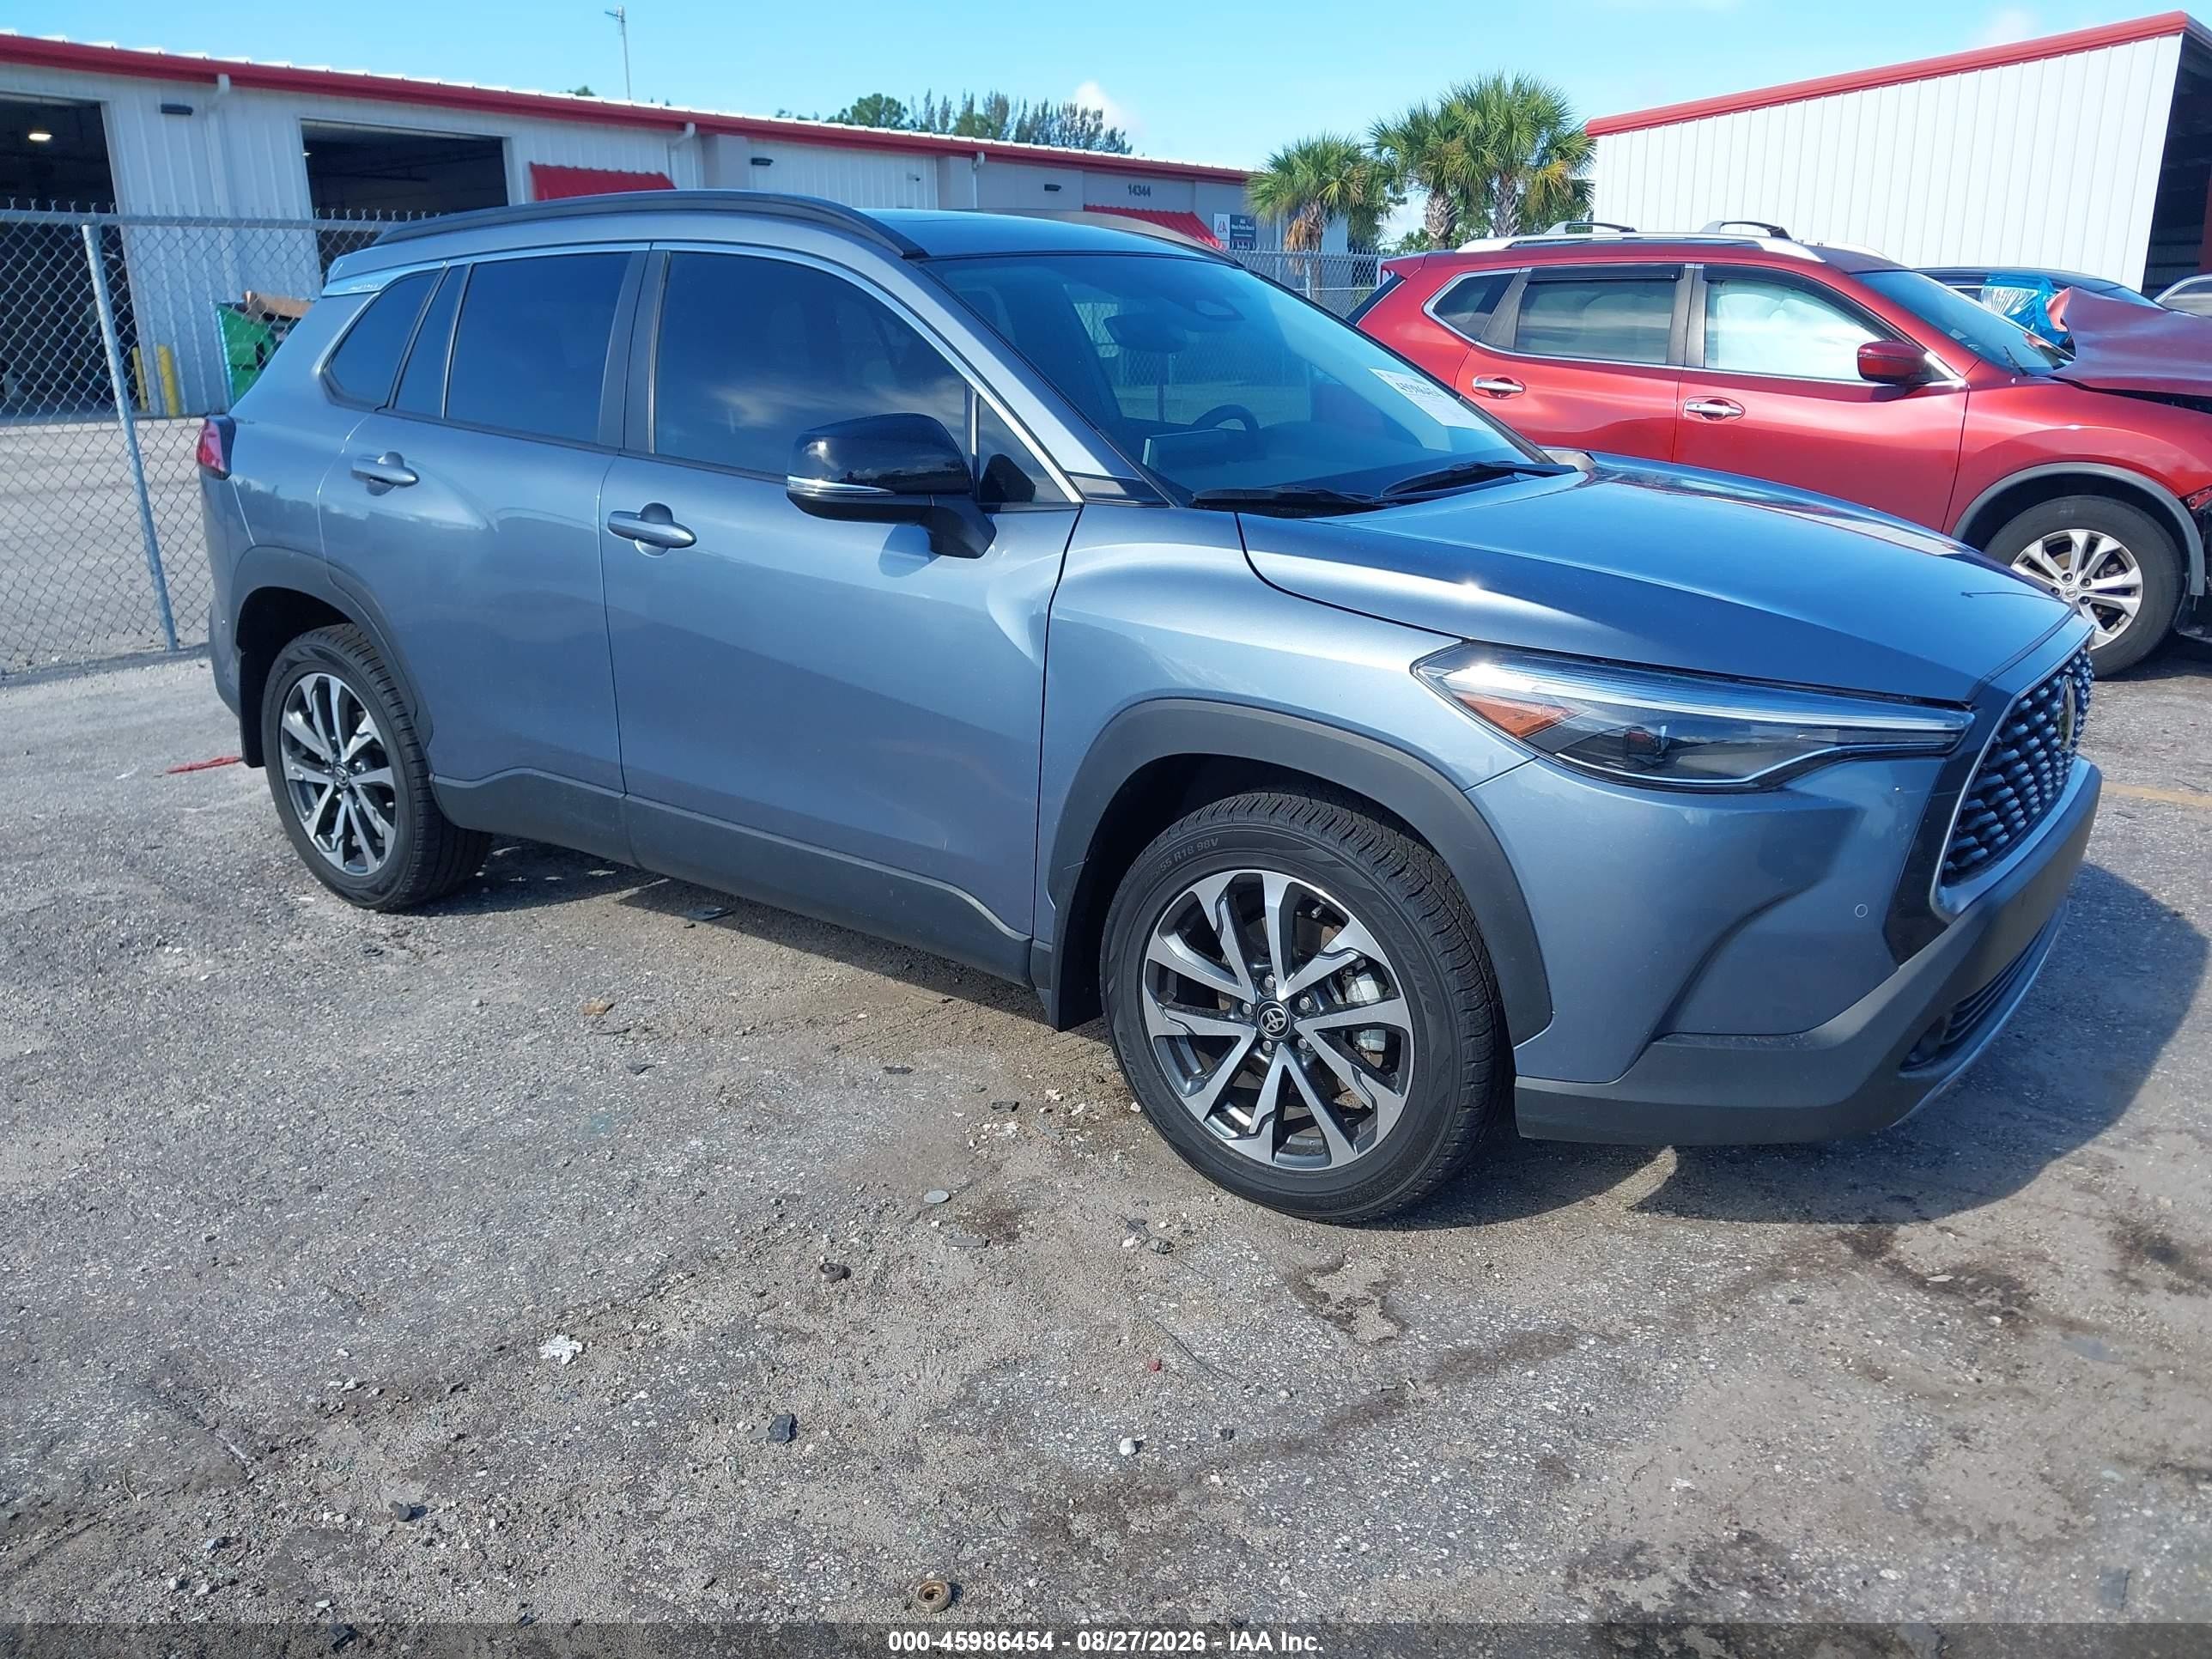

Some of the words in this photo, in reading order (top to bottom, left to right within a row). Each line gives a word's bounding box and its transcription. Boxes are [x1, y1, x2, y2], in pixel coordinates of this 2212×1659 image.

[1127, 183, 1152, 198] 14344
[1173, 845, 1194, 863] R18
[1196, 836, 1218, 852] 98V
